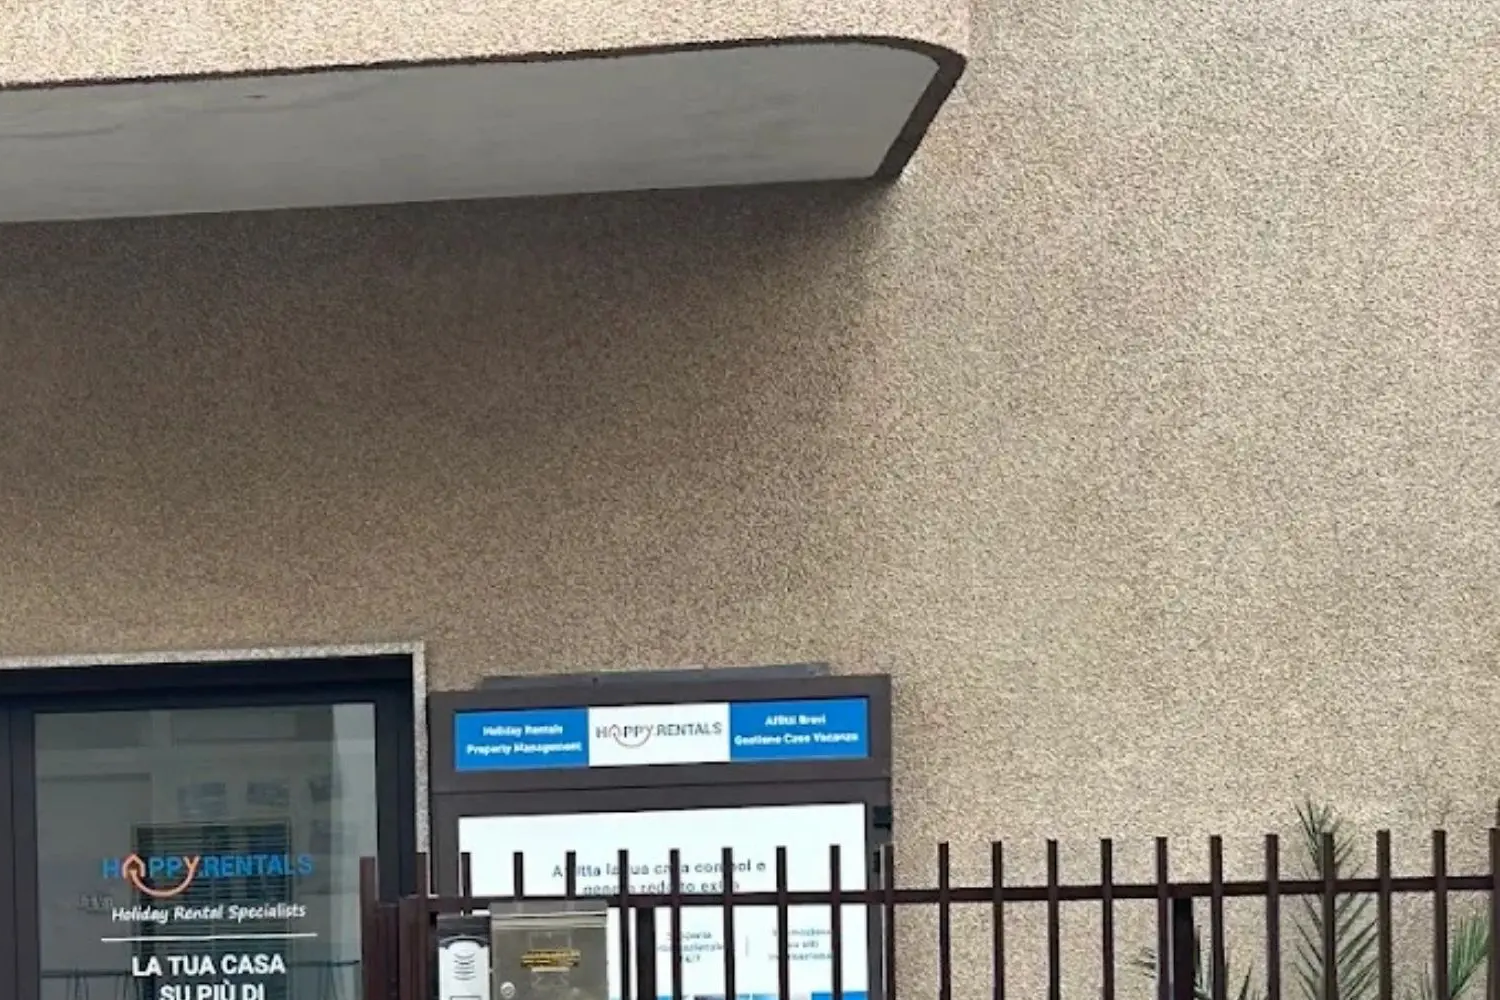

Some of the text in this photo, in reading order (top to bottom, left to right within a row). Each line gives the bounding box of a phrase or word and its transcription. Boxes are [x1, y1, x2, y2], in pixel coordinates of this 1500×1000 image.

[483, 725, 523, 737] Holiday
[467, 741, 582, 756] Property Management
[111, 903, 307, 924] Holiday Rental Specialists
[132, 953, 286, 977] LA TUA CASA
